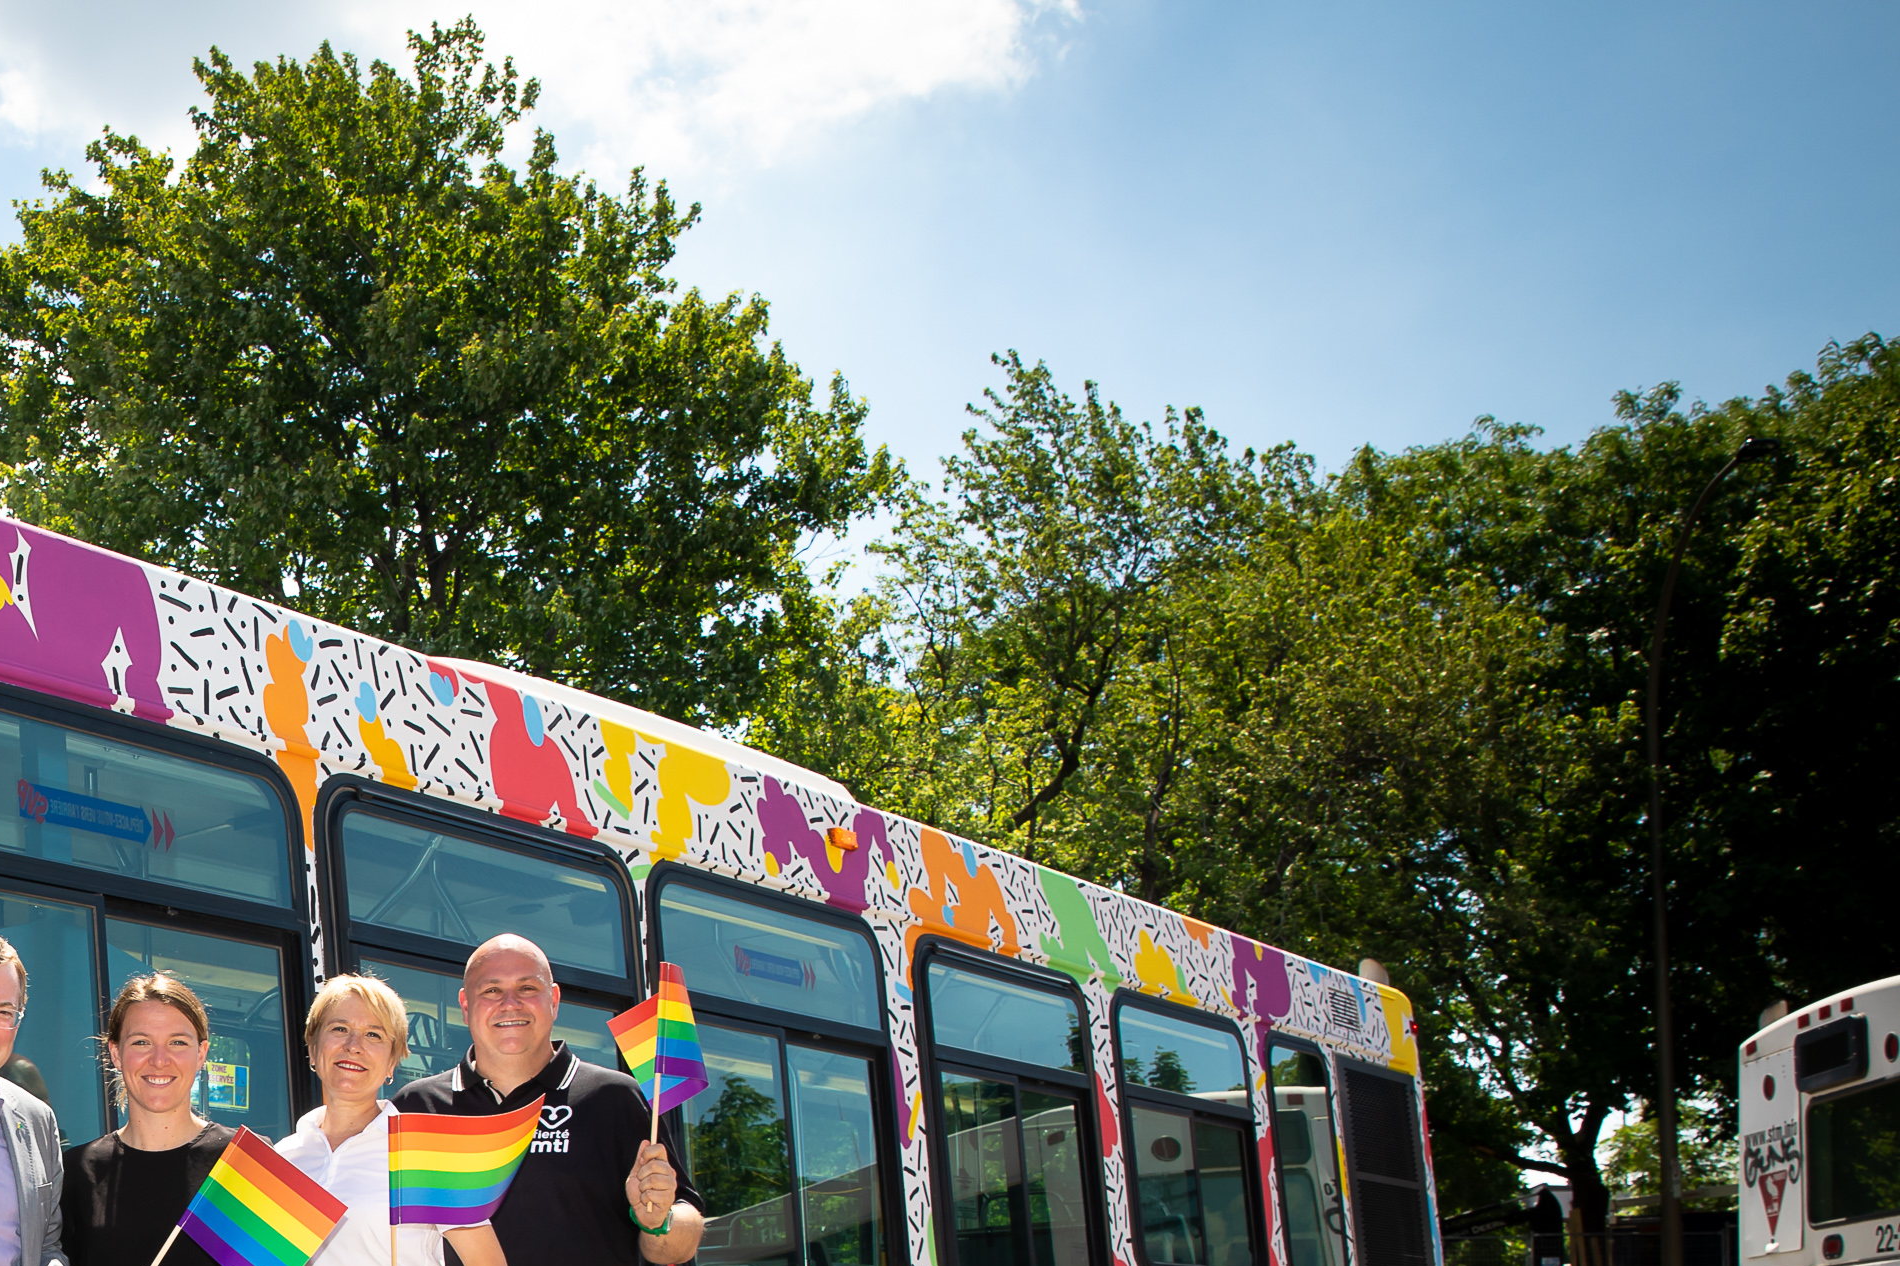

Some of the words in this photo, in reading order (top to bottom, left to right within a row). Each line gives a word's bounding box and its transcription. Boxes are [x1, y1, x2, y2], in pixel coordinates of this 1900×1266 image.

[211, 1064, 227, 1074] ZONE
[532, 1129, 570, 1139] fierté
[530, 1138, 570, 1153] mtl
[1875, 1224, 1900, 1253] 22-
